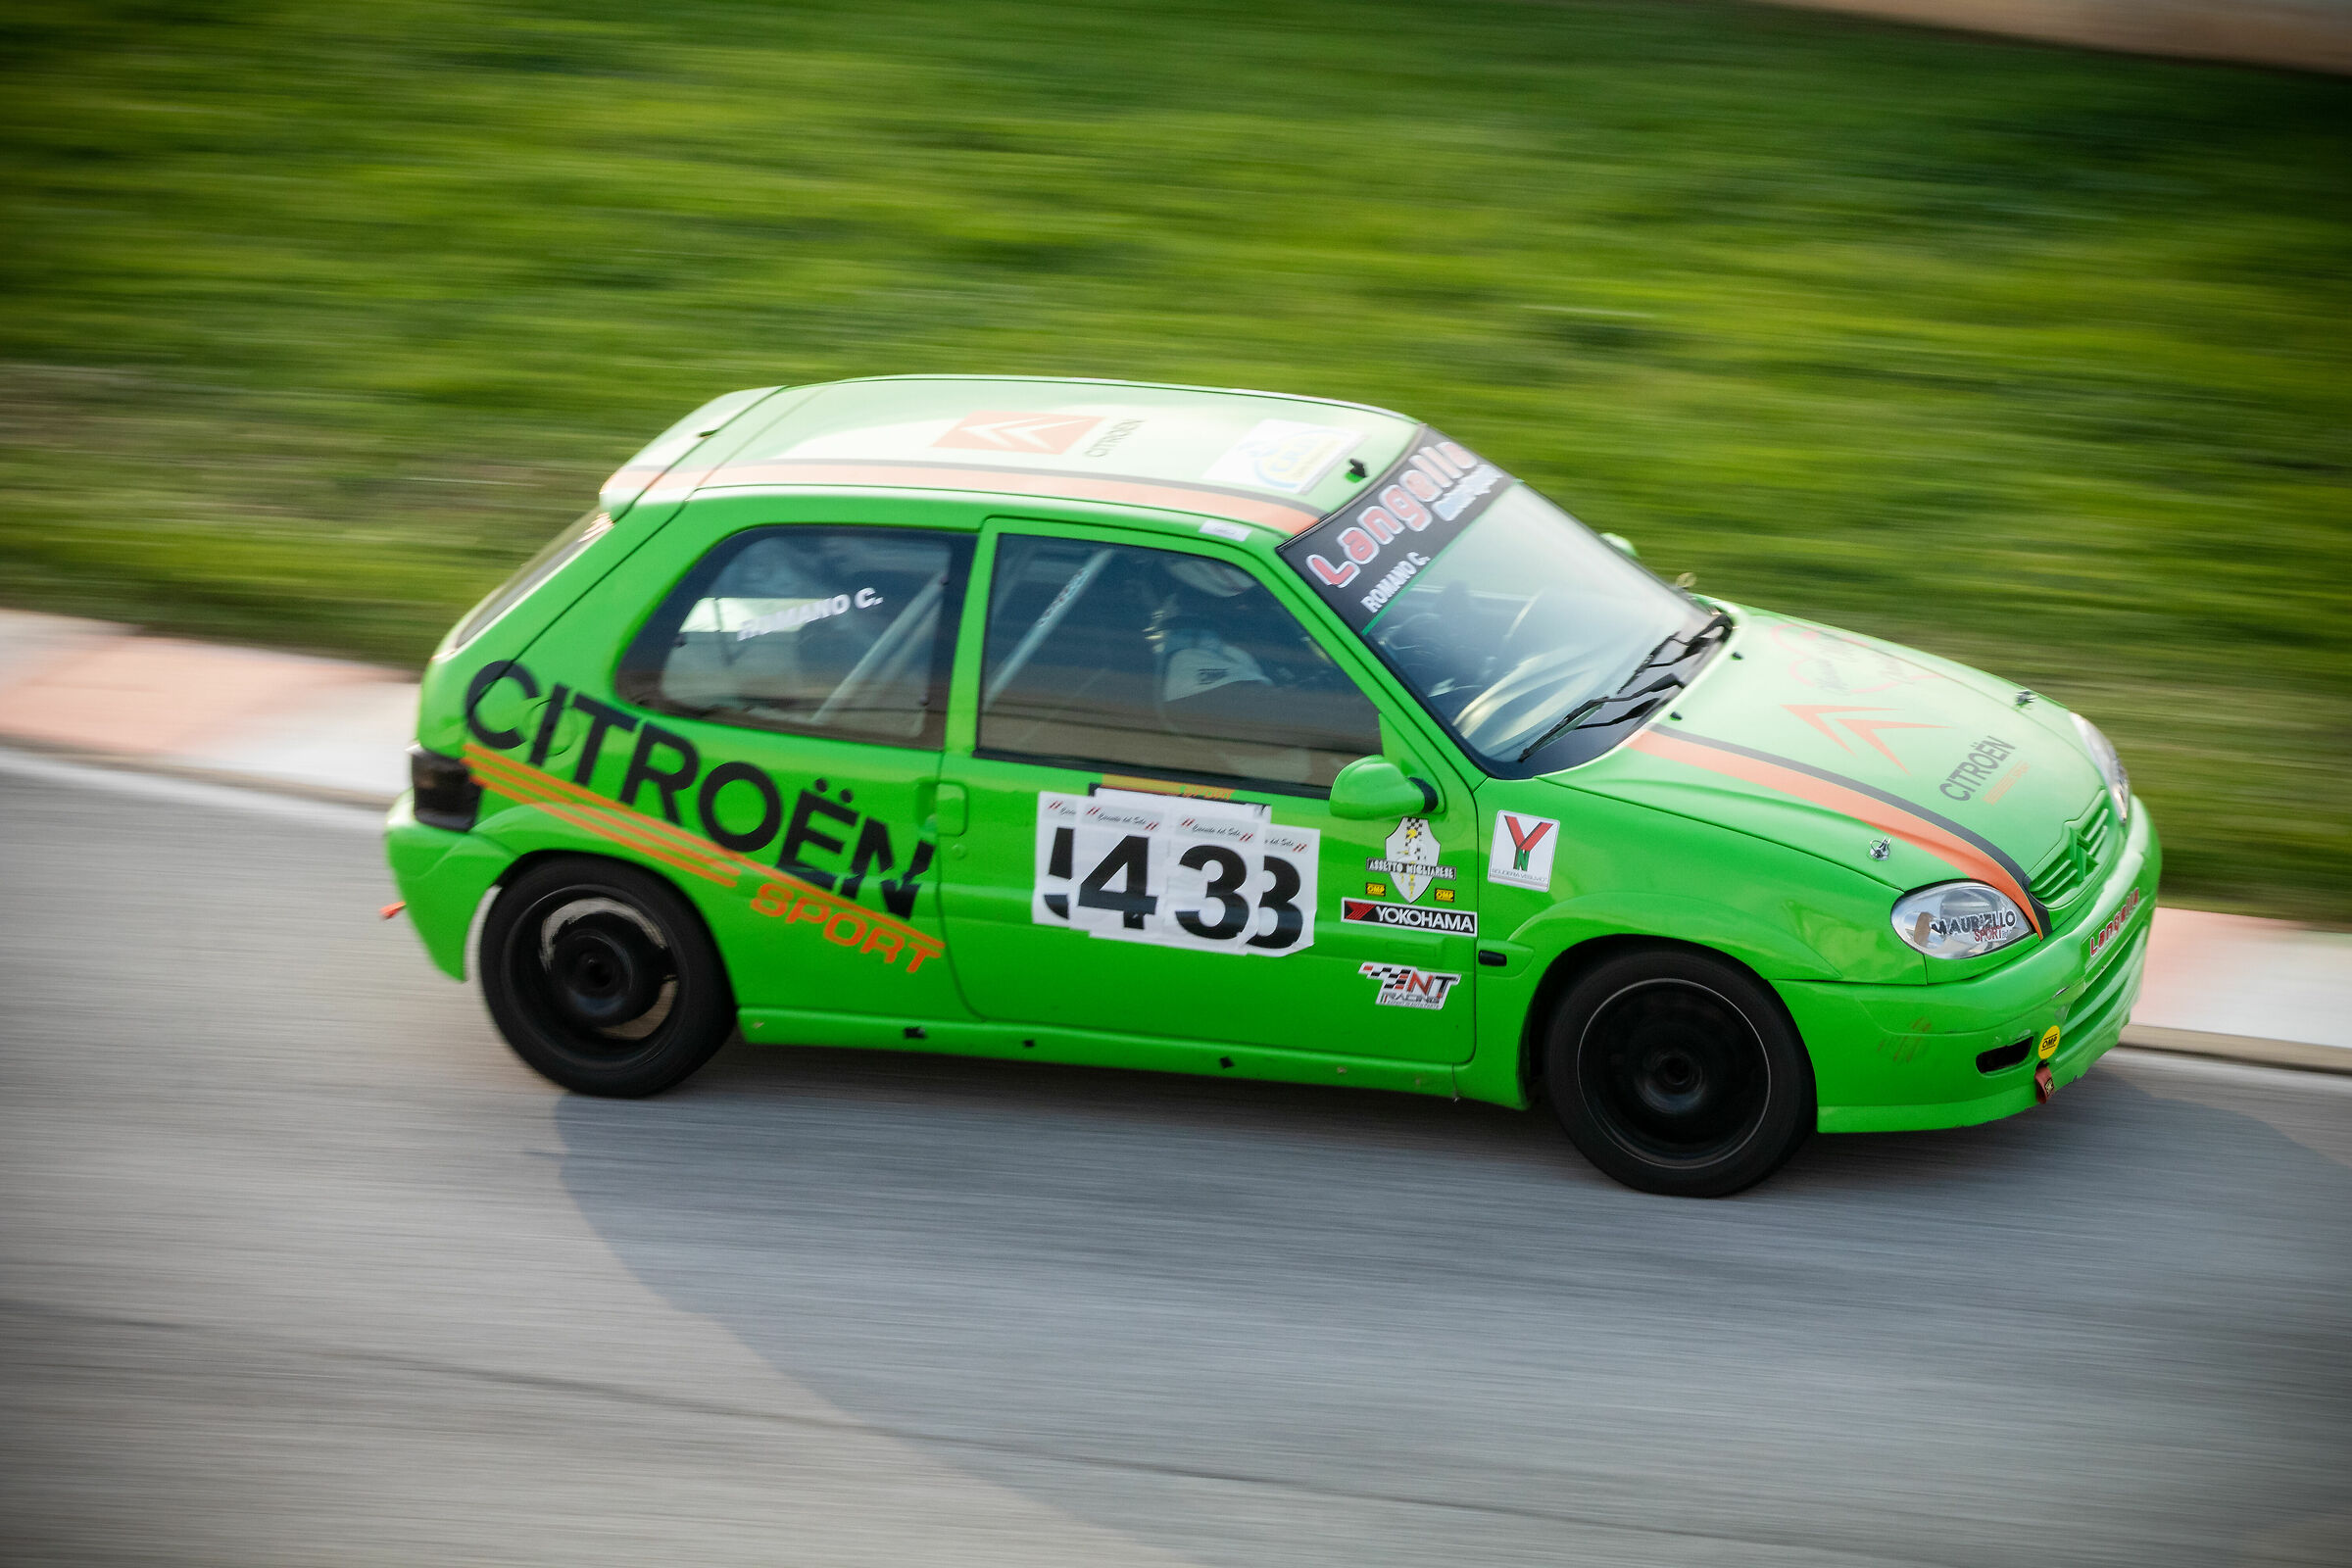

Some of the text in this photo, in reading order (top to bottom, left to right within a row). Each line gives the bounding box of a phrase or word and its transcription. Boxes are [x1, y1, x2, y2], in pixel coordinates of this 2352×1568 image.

[1360, 552, 1431, 612] ROMANO C.
[854, 587, 884, 610] C.
[1938, 735, 2016, 802] CITROËN
[465, 659, 937, 920] CITROËN
[1369, 859, 1454, 878] ASSETTO MIGLIARESE
[1367, 885, 1385, 894] OMP
[1436, 890, 1453, 901] OMP
[749, 882, 944, 973] SPORT
[1375, 905, 1474, 932] YOKOHAMA
[1930, 909, 2017, 935] MAURIELLO
[1974, 926, 2002, 943] SPORT
[2041, 1036, 2058, 1049] OMP
